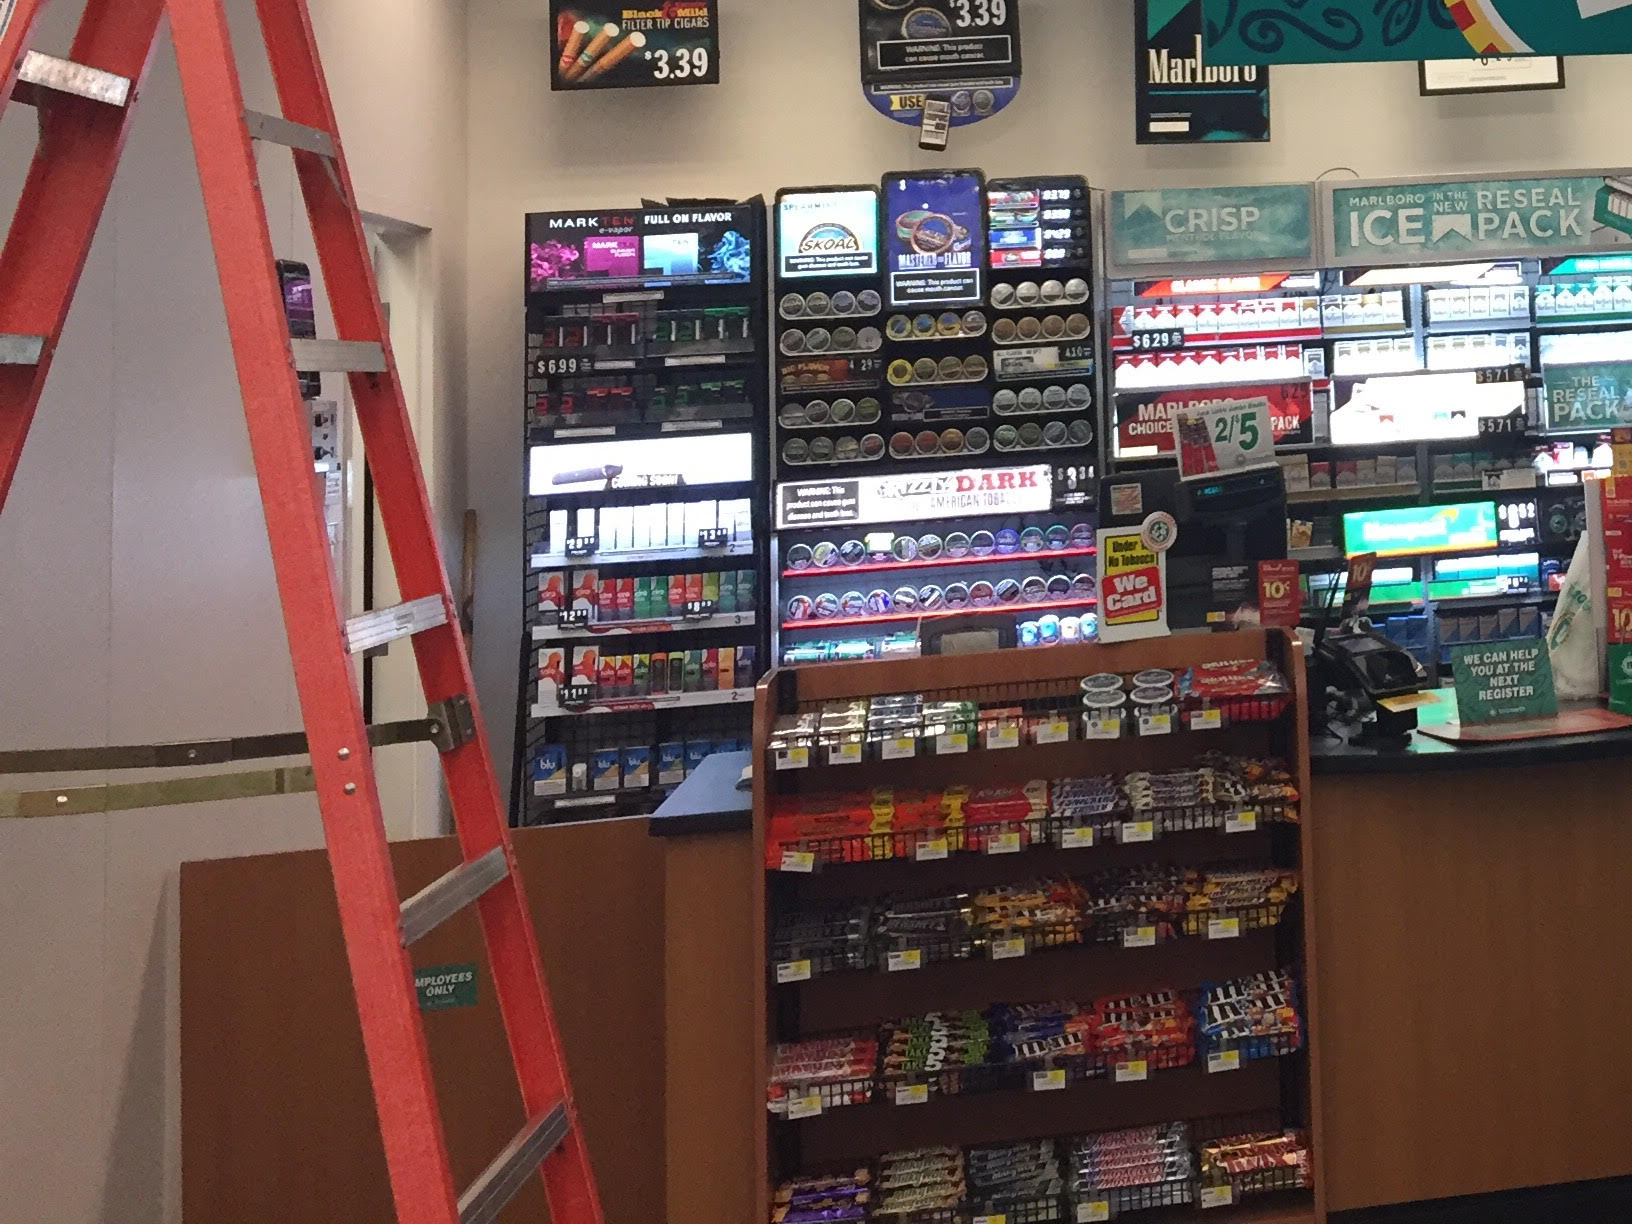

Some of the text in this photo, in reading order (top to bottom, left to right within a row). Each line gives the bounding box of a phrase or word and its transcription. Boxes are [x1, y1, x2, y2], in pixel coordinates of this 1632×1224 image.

[622, 17, 709, 30] FILTER TIP CIGARS
[644, 47, 709, 79] $3.39
[899, 94, 923, 109] USE
[1349, 193, 1425, 207] MARLBORO
[1433, 200, 1469, 213] NEW
[1477, 187, 1581, 210] RESEAL
[549, 216, 634, 229] MARK TEN
[644, 212, 732, 225] FULL ON FLAVOR
[1164, 206, 1260, 234] CRISP
[1478, 208, 1583, 241] PACK
[1350, 207, 1426, 247] ICE
[803, 238, 854, 251] SKOAL
[1572, 375, 1601, 388] THE
[1552, 386, 1621, 402] RESEAL
[1138, 397, 1237, 421] MARL
[1553, 400, 1621, 423] PACK
[1128, 421, 1173, 437] CHOICE
[1271, 415, 1300, 431] PACK
[956, 470, 1038, 493] DARK
[1113, 574, 1148, 593] We
[1263, 580, 1291, 599] 10¢
[1106, 585, 1158, 611] Card
[1464, 648, 1540, 665] WE CAN HELP
[1470, 660, 1536, 677] YOU AT THE
[1490, 674, 1519, 688] NEXT
[1478, 686, 1534, 701] REGISTER
[540, 758, 556, 770] blu
[415, 971, 473, 988] MPLOYEES
[426, 984, 455, 997] ONLY
